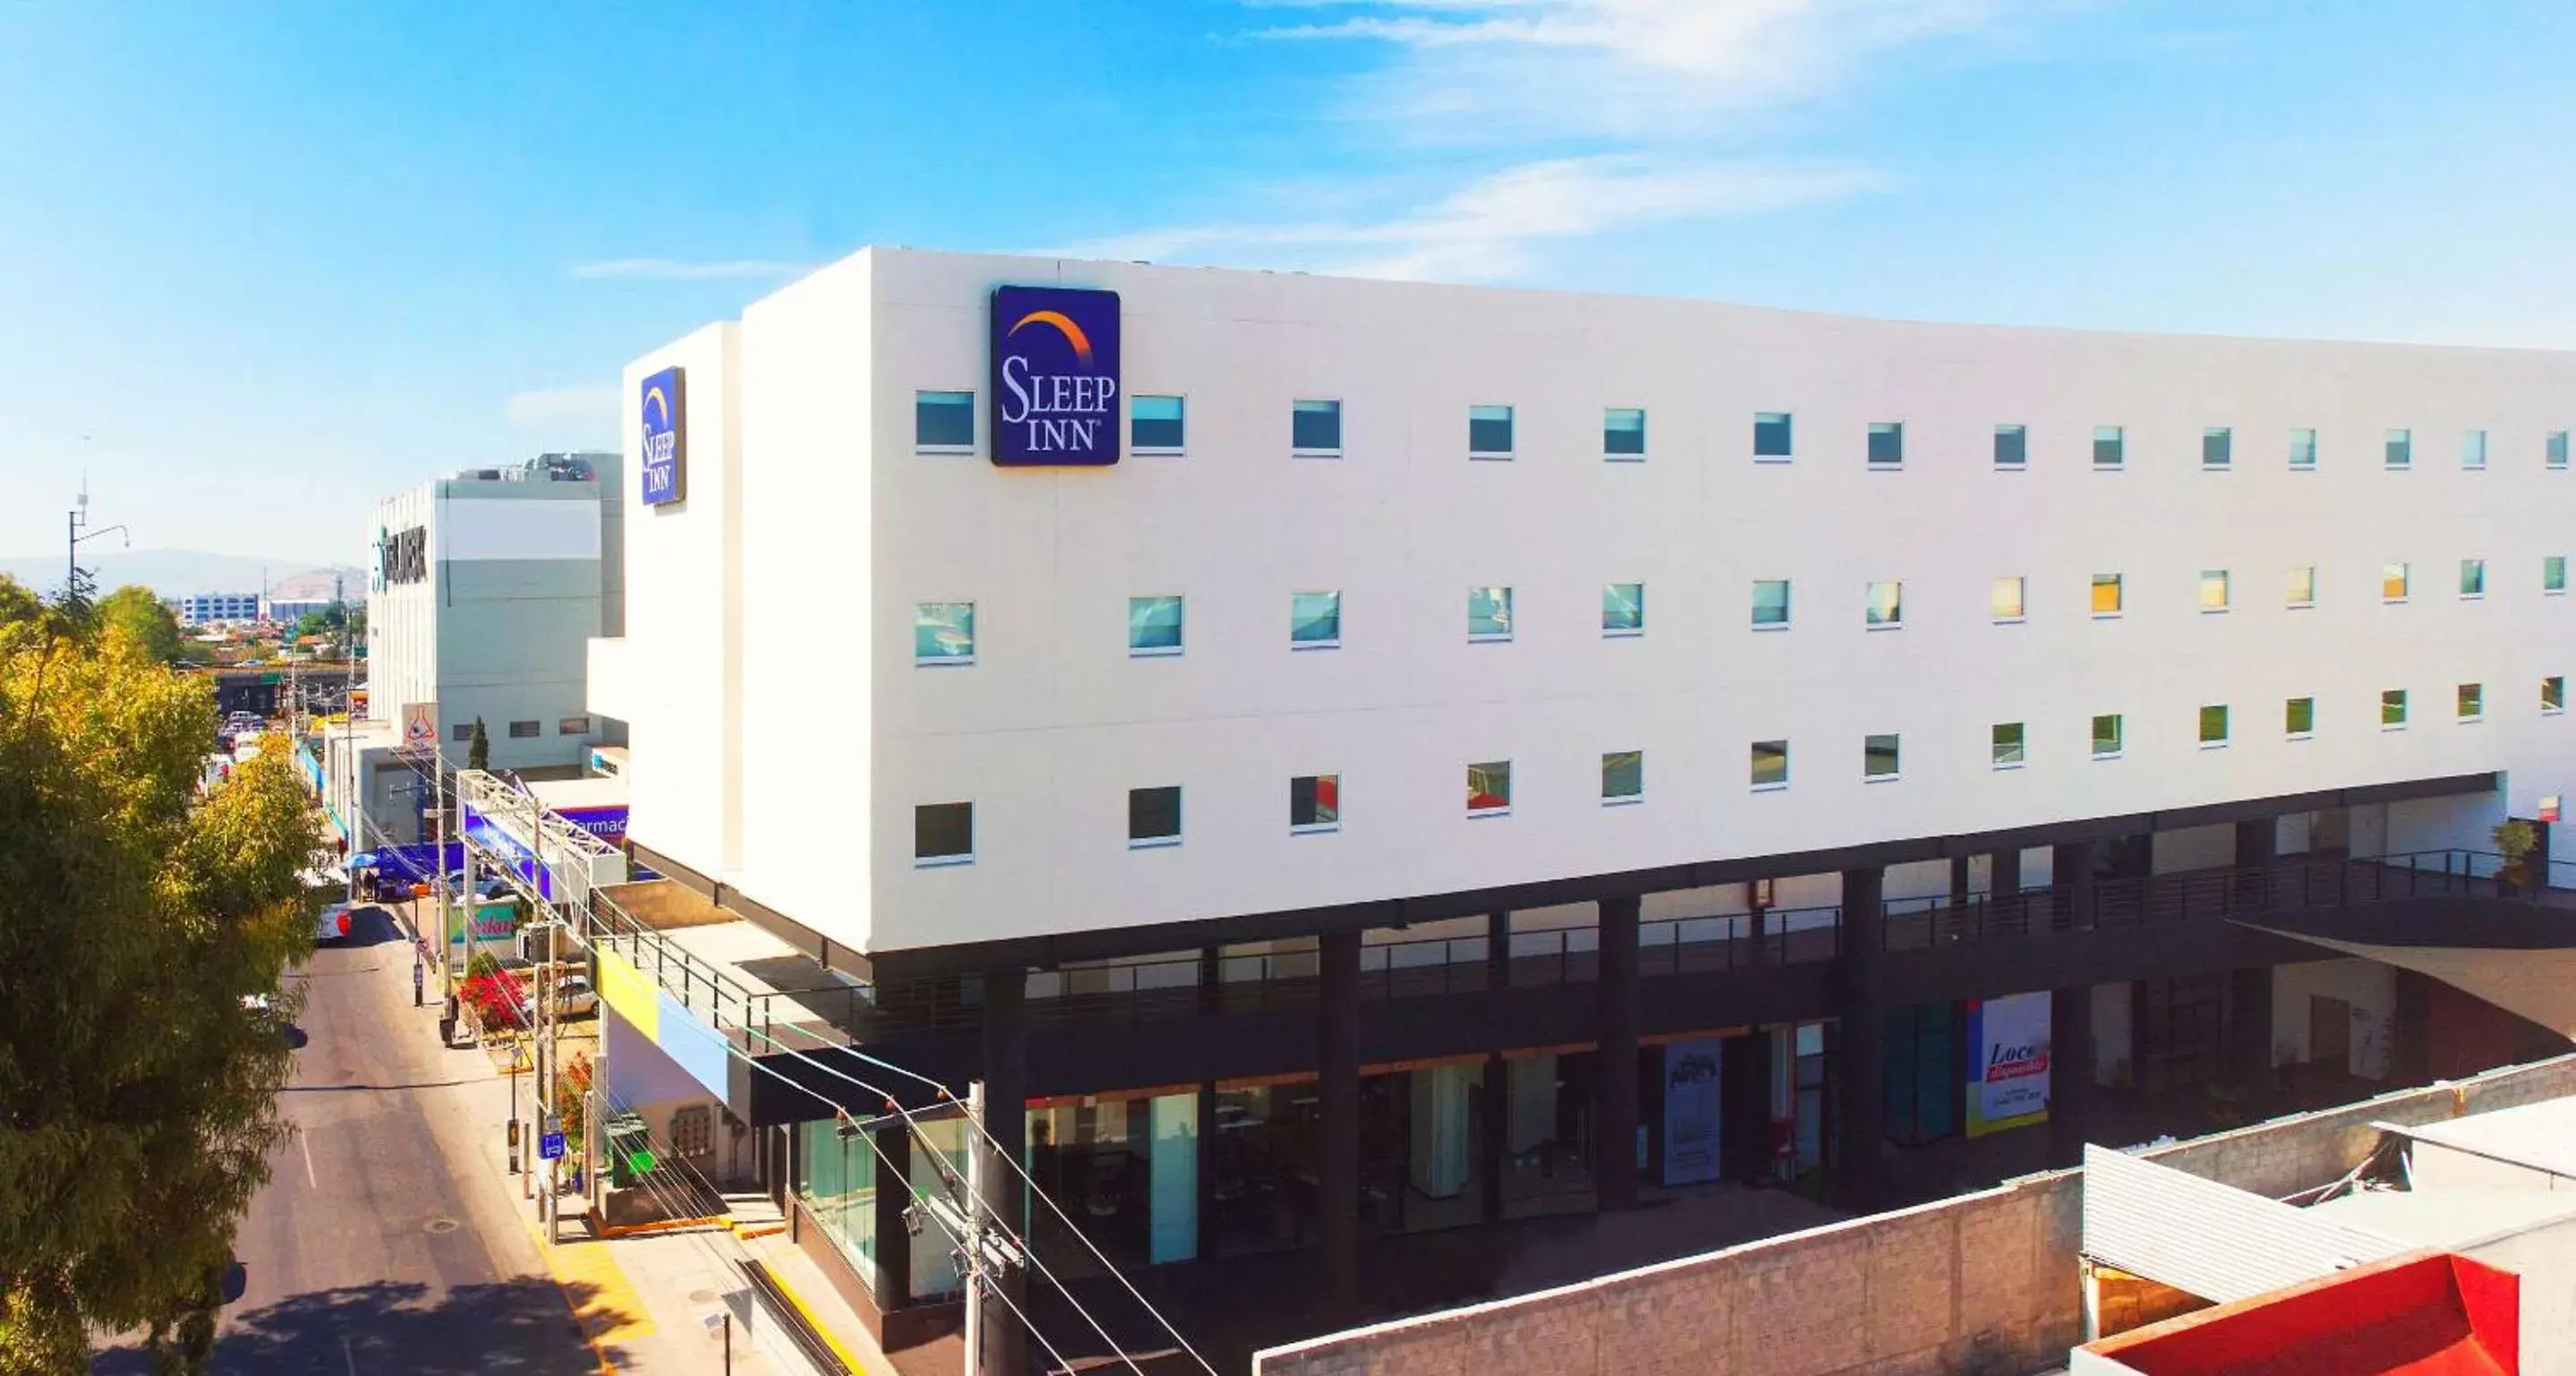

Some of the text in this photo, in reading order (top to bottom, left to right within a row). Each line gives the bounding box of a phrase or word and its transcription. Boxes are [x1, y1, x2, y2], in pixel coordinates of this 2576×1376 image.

[1002, 355, 1115, 423] SLEEP
[643, 423, 675, 473] SLEEP
[1026, 419, 1094, 451] INN
[648, 465, 671, 493] INN
